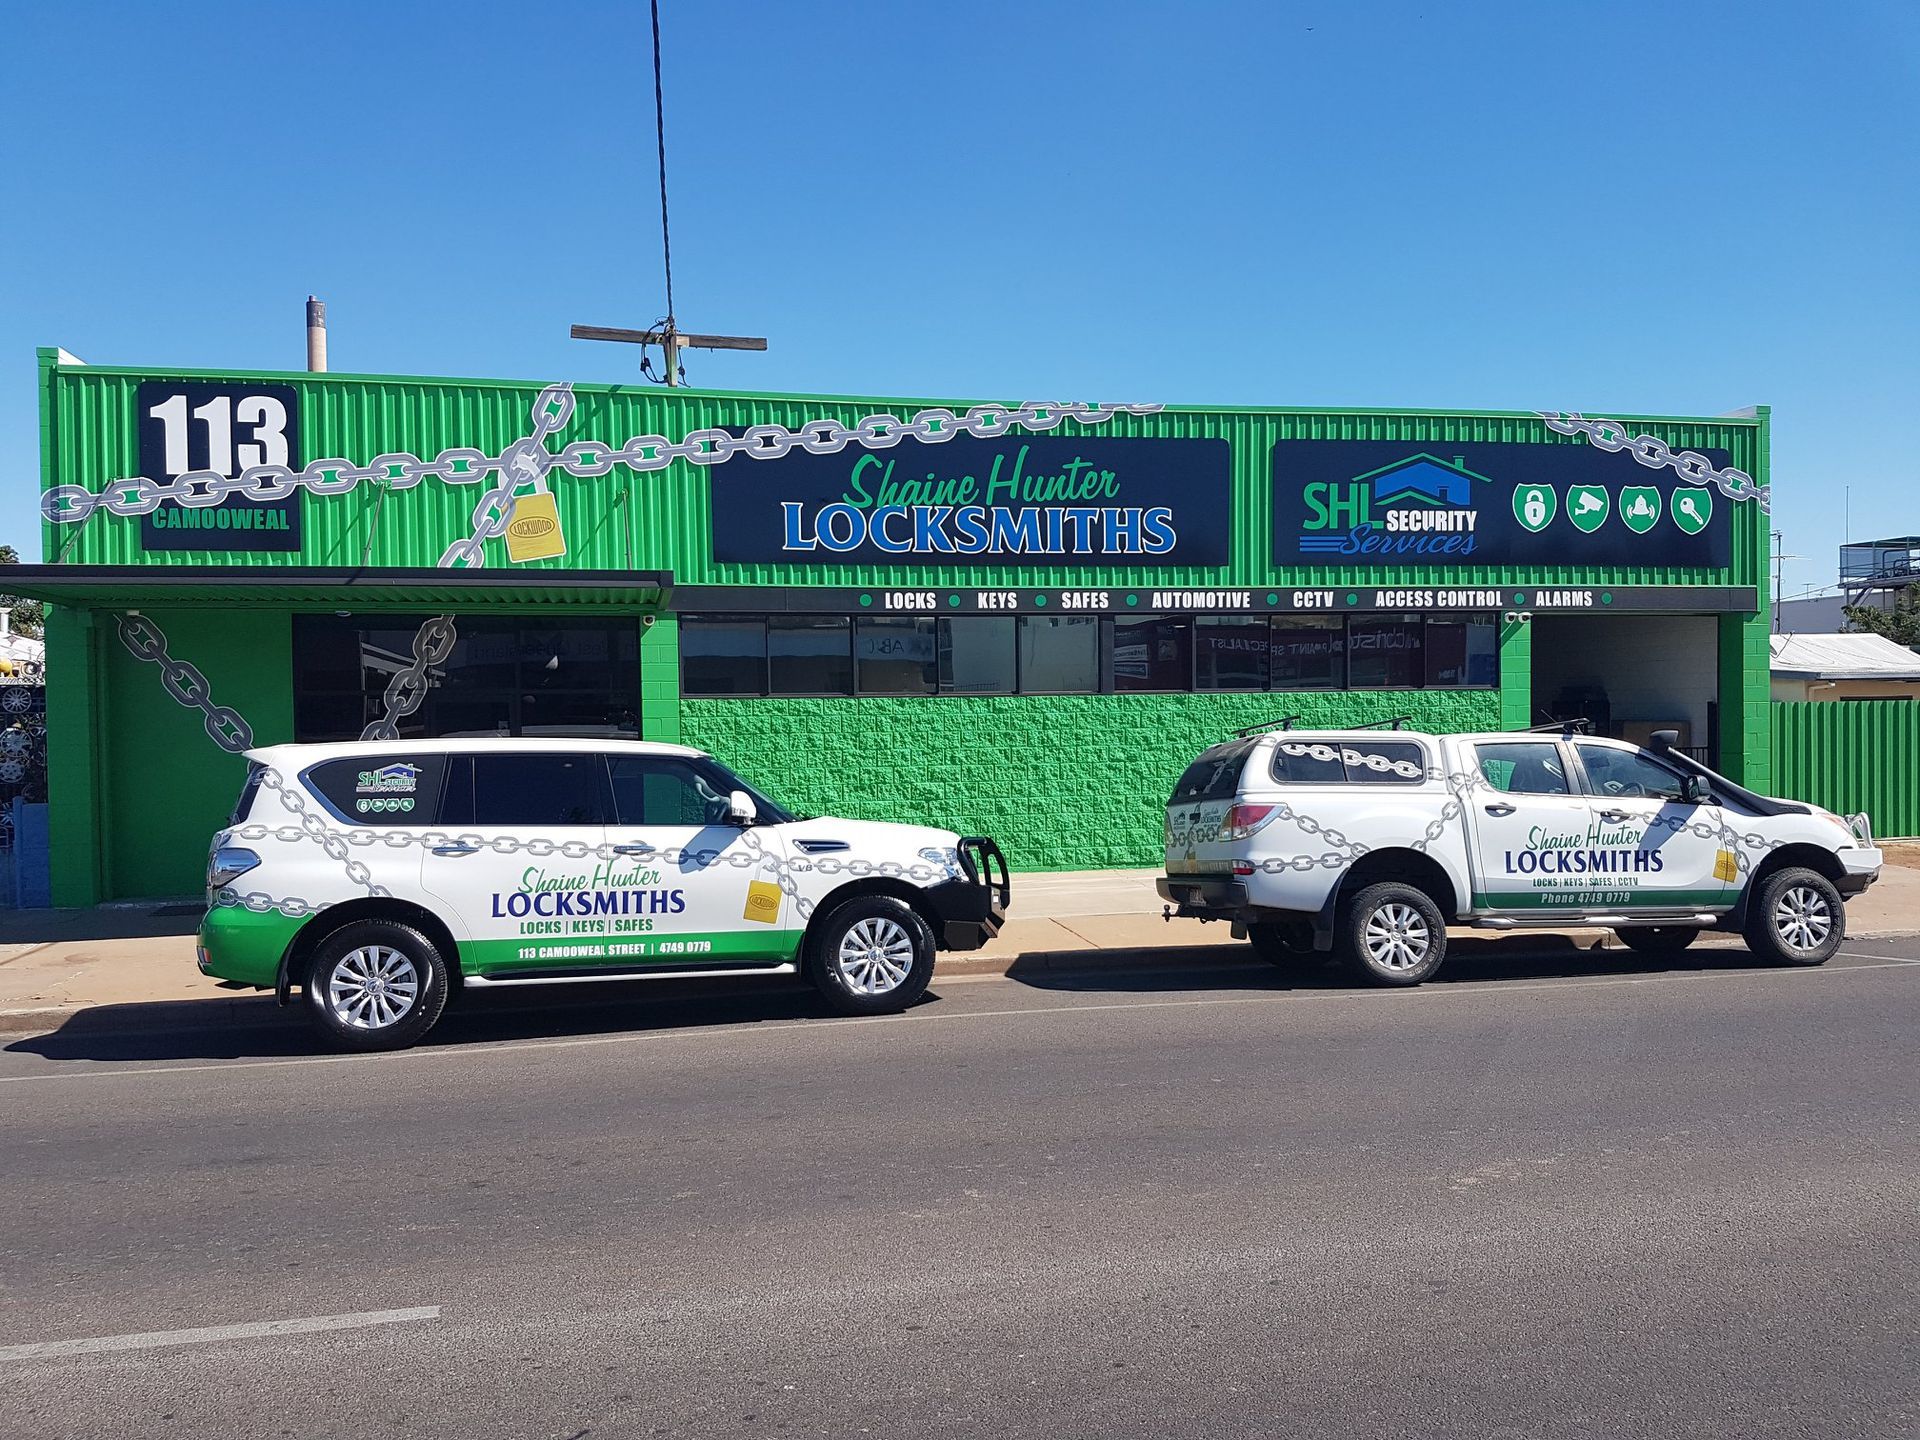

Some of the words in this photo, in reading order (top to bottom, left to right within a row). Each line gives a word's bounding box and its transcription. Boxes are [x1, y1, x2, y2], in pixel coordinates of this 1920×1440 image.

[150, 395, 288, 475] 113
[842, 453, 980, 508] Shaine
[986, 445, 1120, 505] Hunter
[1303, 482, 1384, 529] SHL
[152, 507, 290, 530] CAMOOWEAL
[781, 501, 1177, 555] LOCKSMITHS
[1386, 510, 1477, 532] SECURITY
[1340, 523, 1478, 555] Services
[885, 593, 936, 609] LOCKS
[978, 592, 1017, 609] KEYS
[1061, 592, 1109, 608] SAFES
[1152, 592, 1250, 608] AUTOMOTIVE
[1293, 592, 1334, 607] CCTV
[1375, 591, 1433, 607] ACCESS
[1437, 590, 1503, 607] CONTROL
[1536, 591, 1593, 607] ALARMS
[1525, 825, 1584, 851] Shaine
[1585, 820, 1642, 847] Hunter
[1505, 849, 1664, 874] LOCKSMITHS
[517, 866, 588, 894] Shaine
[592, 859, 661, 890] Hunter
[1532, 877, 1558, 888] LOCKS
[1563, 877, 1584, 888] KEYS
[1588, 877, 1613, 888] SAFES
[1617, 877, 1639, 887] CCTV
[491, 889, 686, 918] LOCKSMITHS
[1541, 892, 1575, 904] Phone
[1605, 891, 1631, 903] 0779
[520, 920, 562, 935] LOCKS
[572, 920, 605, 934] KEYS
[615, 918, 653, 932] SAFES
[518, 947, 536, 959] 113
[538, 945, 605, 959] CAMOOWEAL
[608, 943, 646, 956] STREET
[659, 941, 685, 954] 4749
[687, 941, 711, 953] 0779
